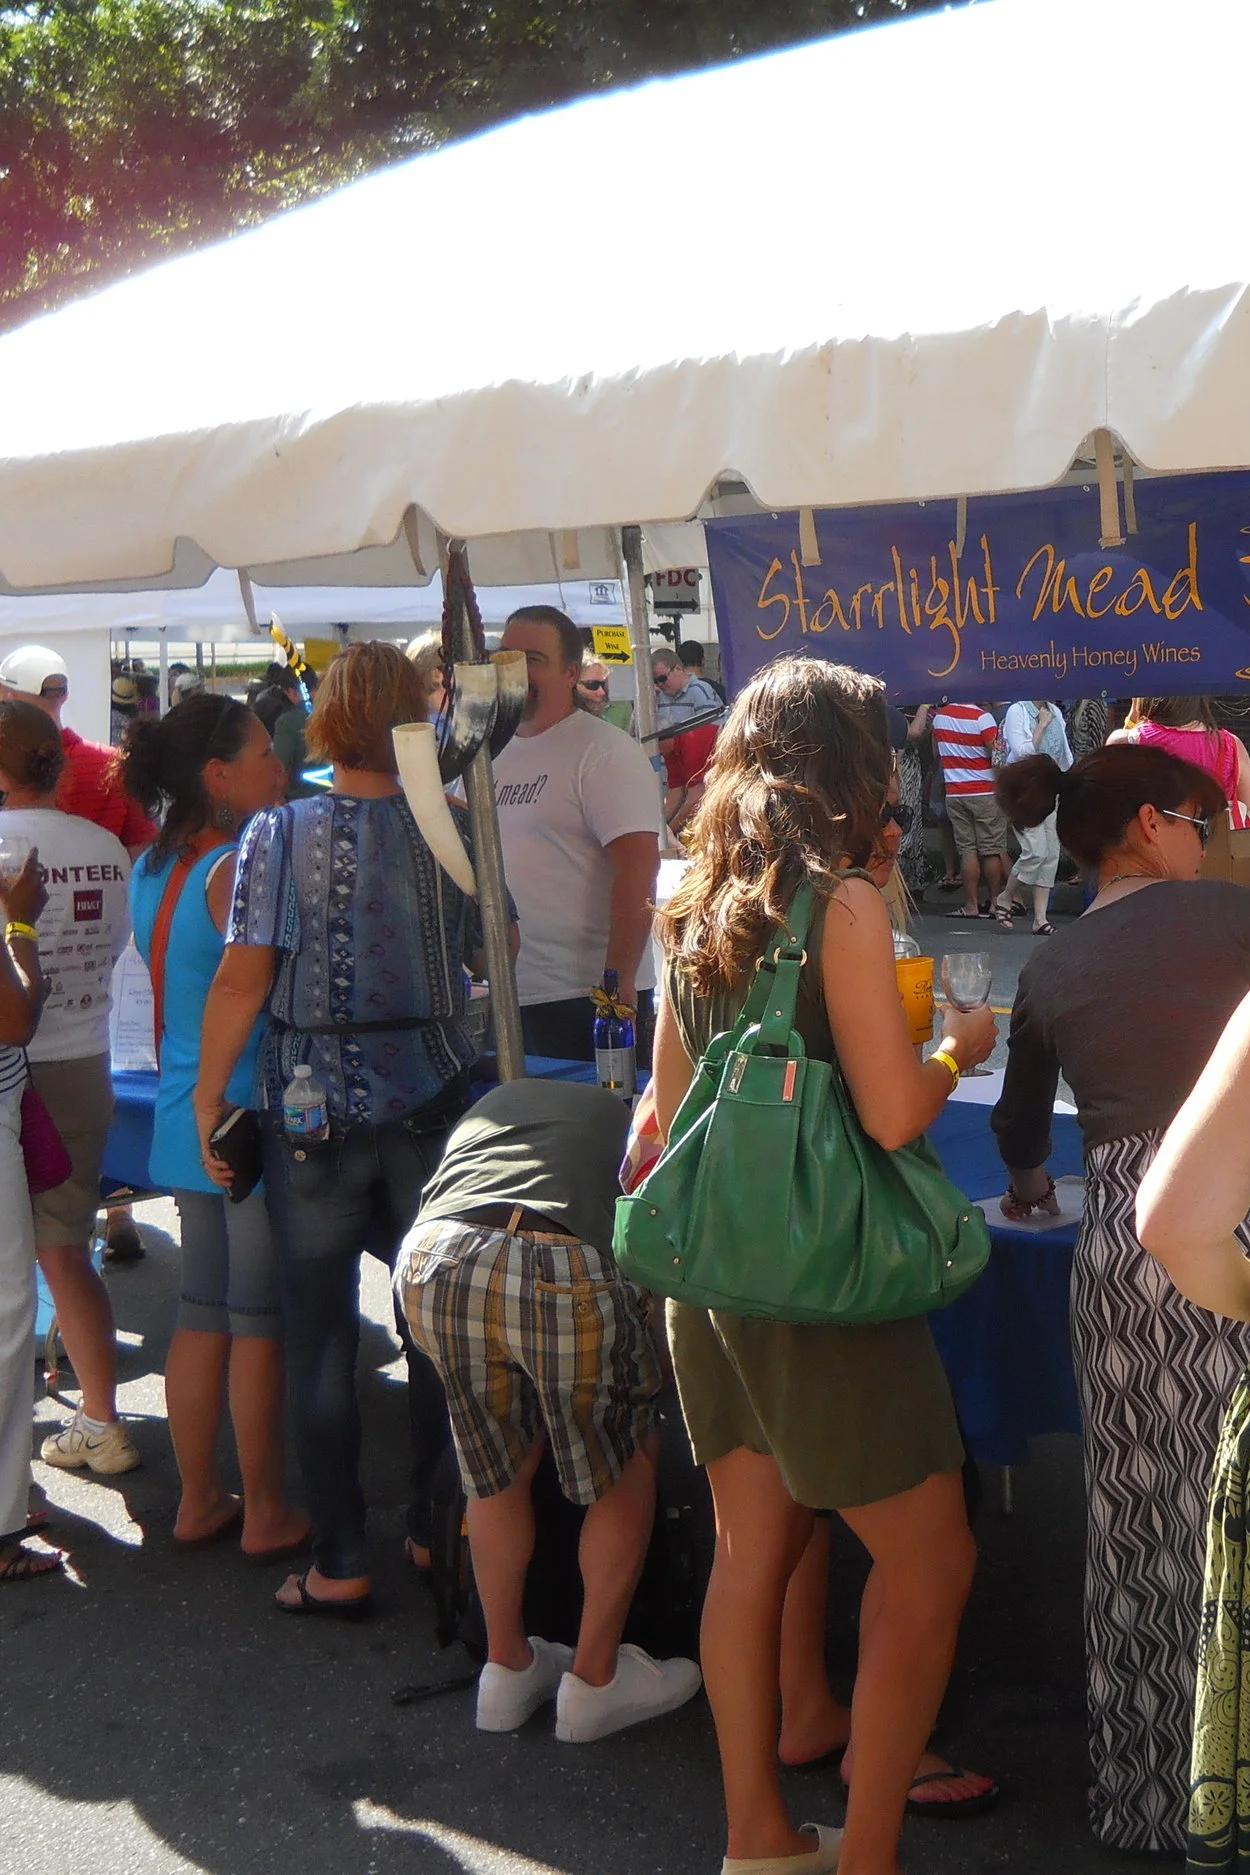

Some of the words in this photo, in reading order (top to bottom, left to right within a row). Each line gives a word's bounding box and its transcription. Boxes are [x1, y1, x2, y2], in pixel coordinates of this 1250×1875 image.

[757, 533, 1000, 677] Starrlight
[1016, 522, 1204, 621] Mead
[596, 628, 626, 638] PURCHASE
[980, 640, 1067, 679] Heavenly
[1072, 646, 1137, 677] Honey
[1142, 641, 1202, 664] Wines
[496, 774, 549, 806] mead?
